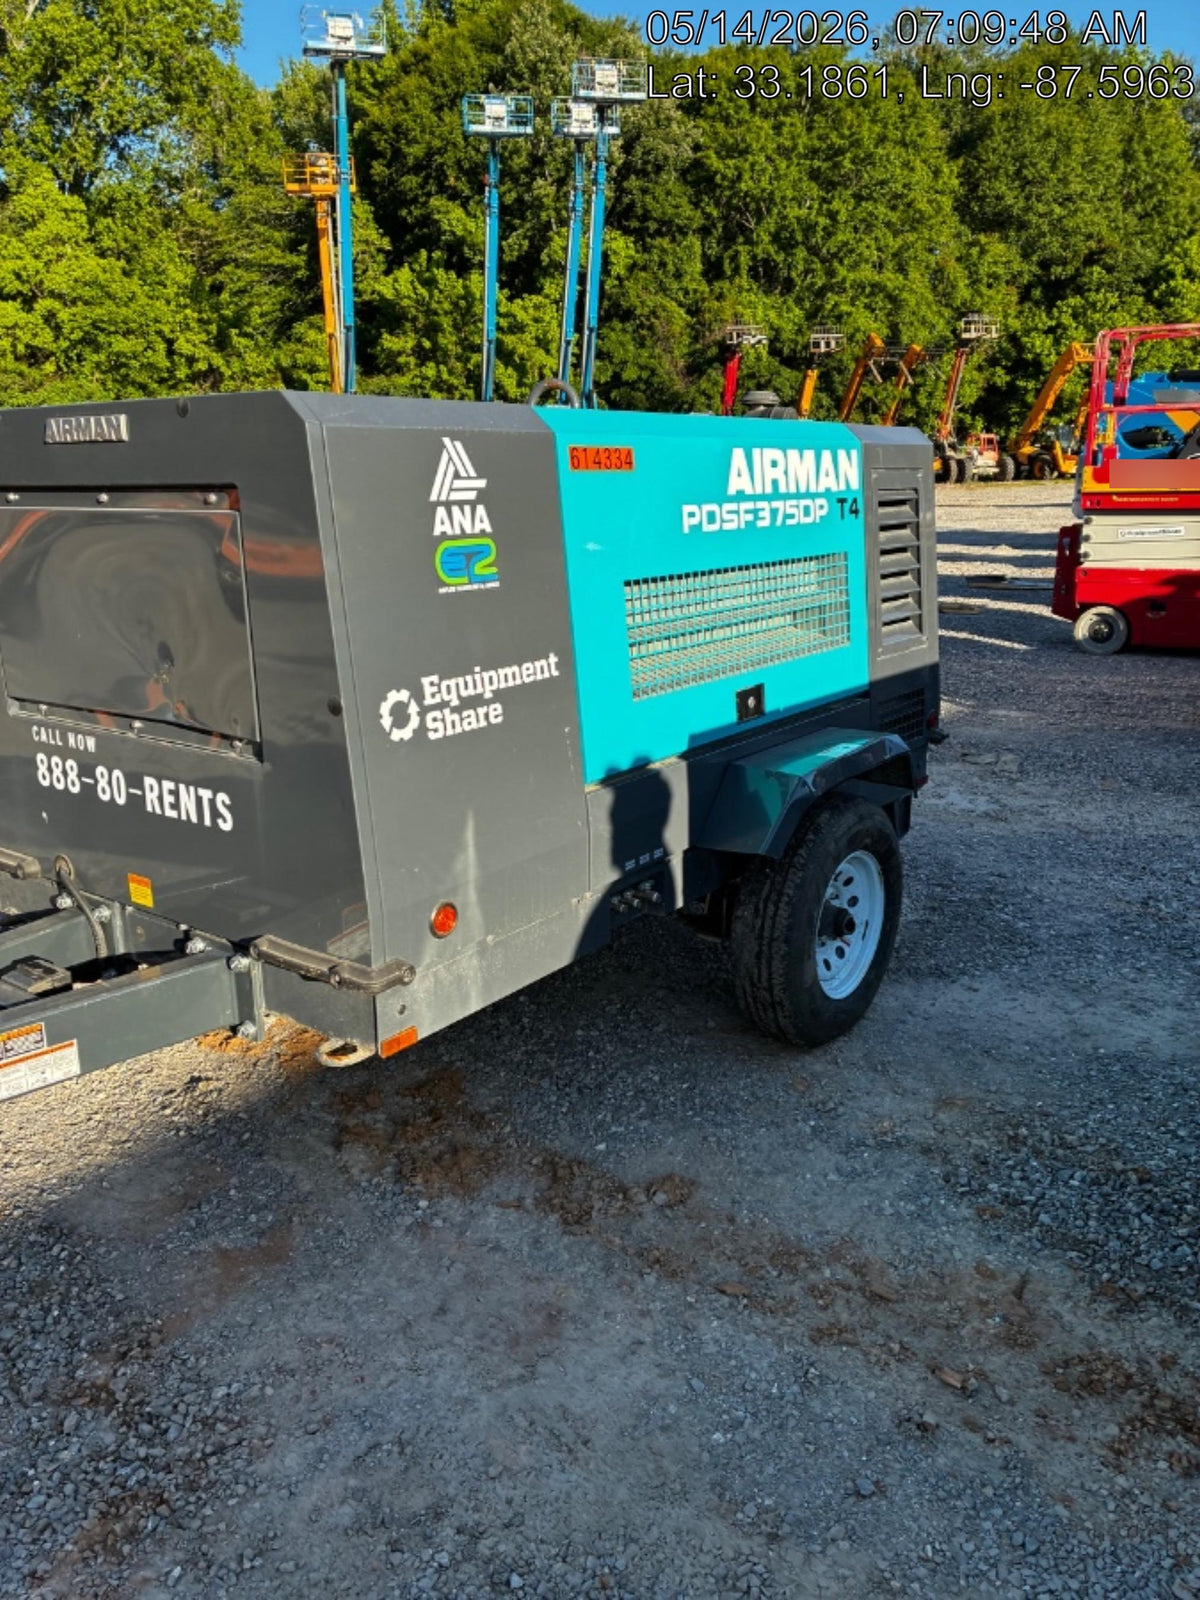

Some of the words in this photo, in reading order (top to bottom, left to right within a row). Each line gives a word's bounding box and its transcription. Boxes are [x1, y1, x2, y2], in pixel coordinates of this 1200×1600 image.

[46, 414, 125, 443] AIRMAN
[570, 446, 633, 471] 614334
[727, 447, 860, 496] AIRMAN
[432, 504, 493, 536] ANA
[837, 497, 860, 521] T4
[420, 652, 560, 707] Equipment
[425, 702, 504, 740] Share
[31, 725, 63, 746] CALL
[68, 732, 97, 753] NOW
[36, 752, 234, 832] 888-80-RENTS
